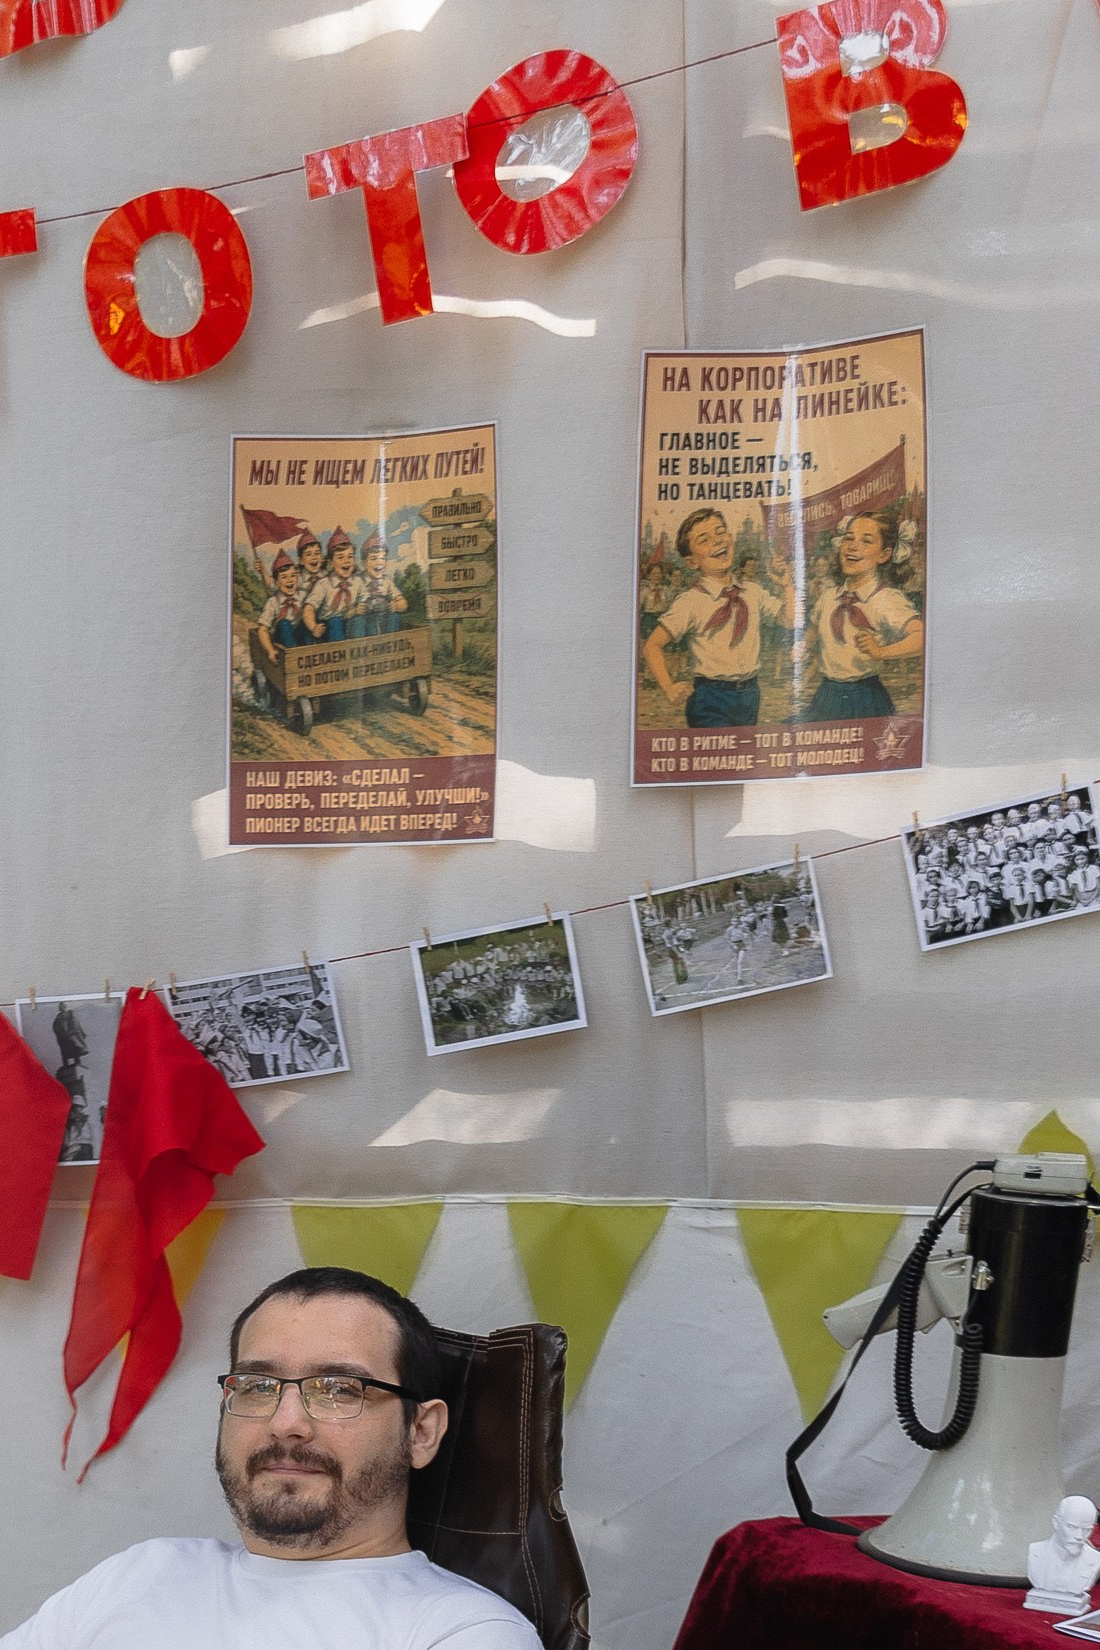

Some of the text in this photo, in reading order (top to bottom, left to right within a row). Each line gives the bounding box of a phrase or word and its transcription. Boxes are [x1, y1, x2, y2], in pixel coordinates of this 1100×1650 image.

[662, 355, 860, 392] НА КОРПОРАТИВЕ
[697, 379, 907, 424] КАК НА ЛИНЕЙКЕ:
[659, 432, 741, 451] ГЛАВНОЕ
[248, 443, 485, 489] МЫ НЕ ИЩЕМ ЛЕГКИХ ПУТЕЙ!
[658, 452, 819, 478] НЕ ВЫДЕЛЯТЬСЯ,
[657, 479, 792, 502] НО ТАНЦЕВАТЬ!
[432, 501, 481, 518] ПРАВИЛЬНО
[441, 534, 478, 550] БЫСТРО
[445, 568, 475, 582] ЛЕГКО
[297, 650, 346, 669] СДЕЛАЕМ
[298, 674, 311, 687] НО
[314, 668, 348, 684] ПОТОМ
[651, 737, 676, 752] КТО
[680, 736, 689, 751] В
[693, 735, 737, 750] РИТМЕ
[755, 733, 780, 748] ТОТ
[782, 732, 792, 747] В
[795, 727, 863, 746] КОМАНДЕ!
[651, 758, 676, 773] КТО
[680, 757, 689, 772] В
[693, 755, 755, 771] КОМАНДЕ
[769, 753, 793, 768] ТОТ
[797, 748, 864, 766] МОЛОДЕЦ!
[246, 771, 280, 787] НАШ
[285, 770, 337, 789] ДЕВИЗ:
[342, 768, 410, 788] «СДЕЛАЛ
[246, 787, 490, 810] ПРОВЕРЬ, ПЕРЕДЕЛАЙ, УЛУЧШИ!»
[246, 813, 458, 834] ПИОНЕР ВСЕГДА ИДЕТ ВПЕРЕД!
